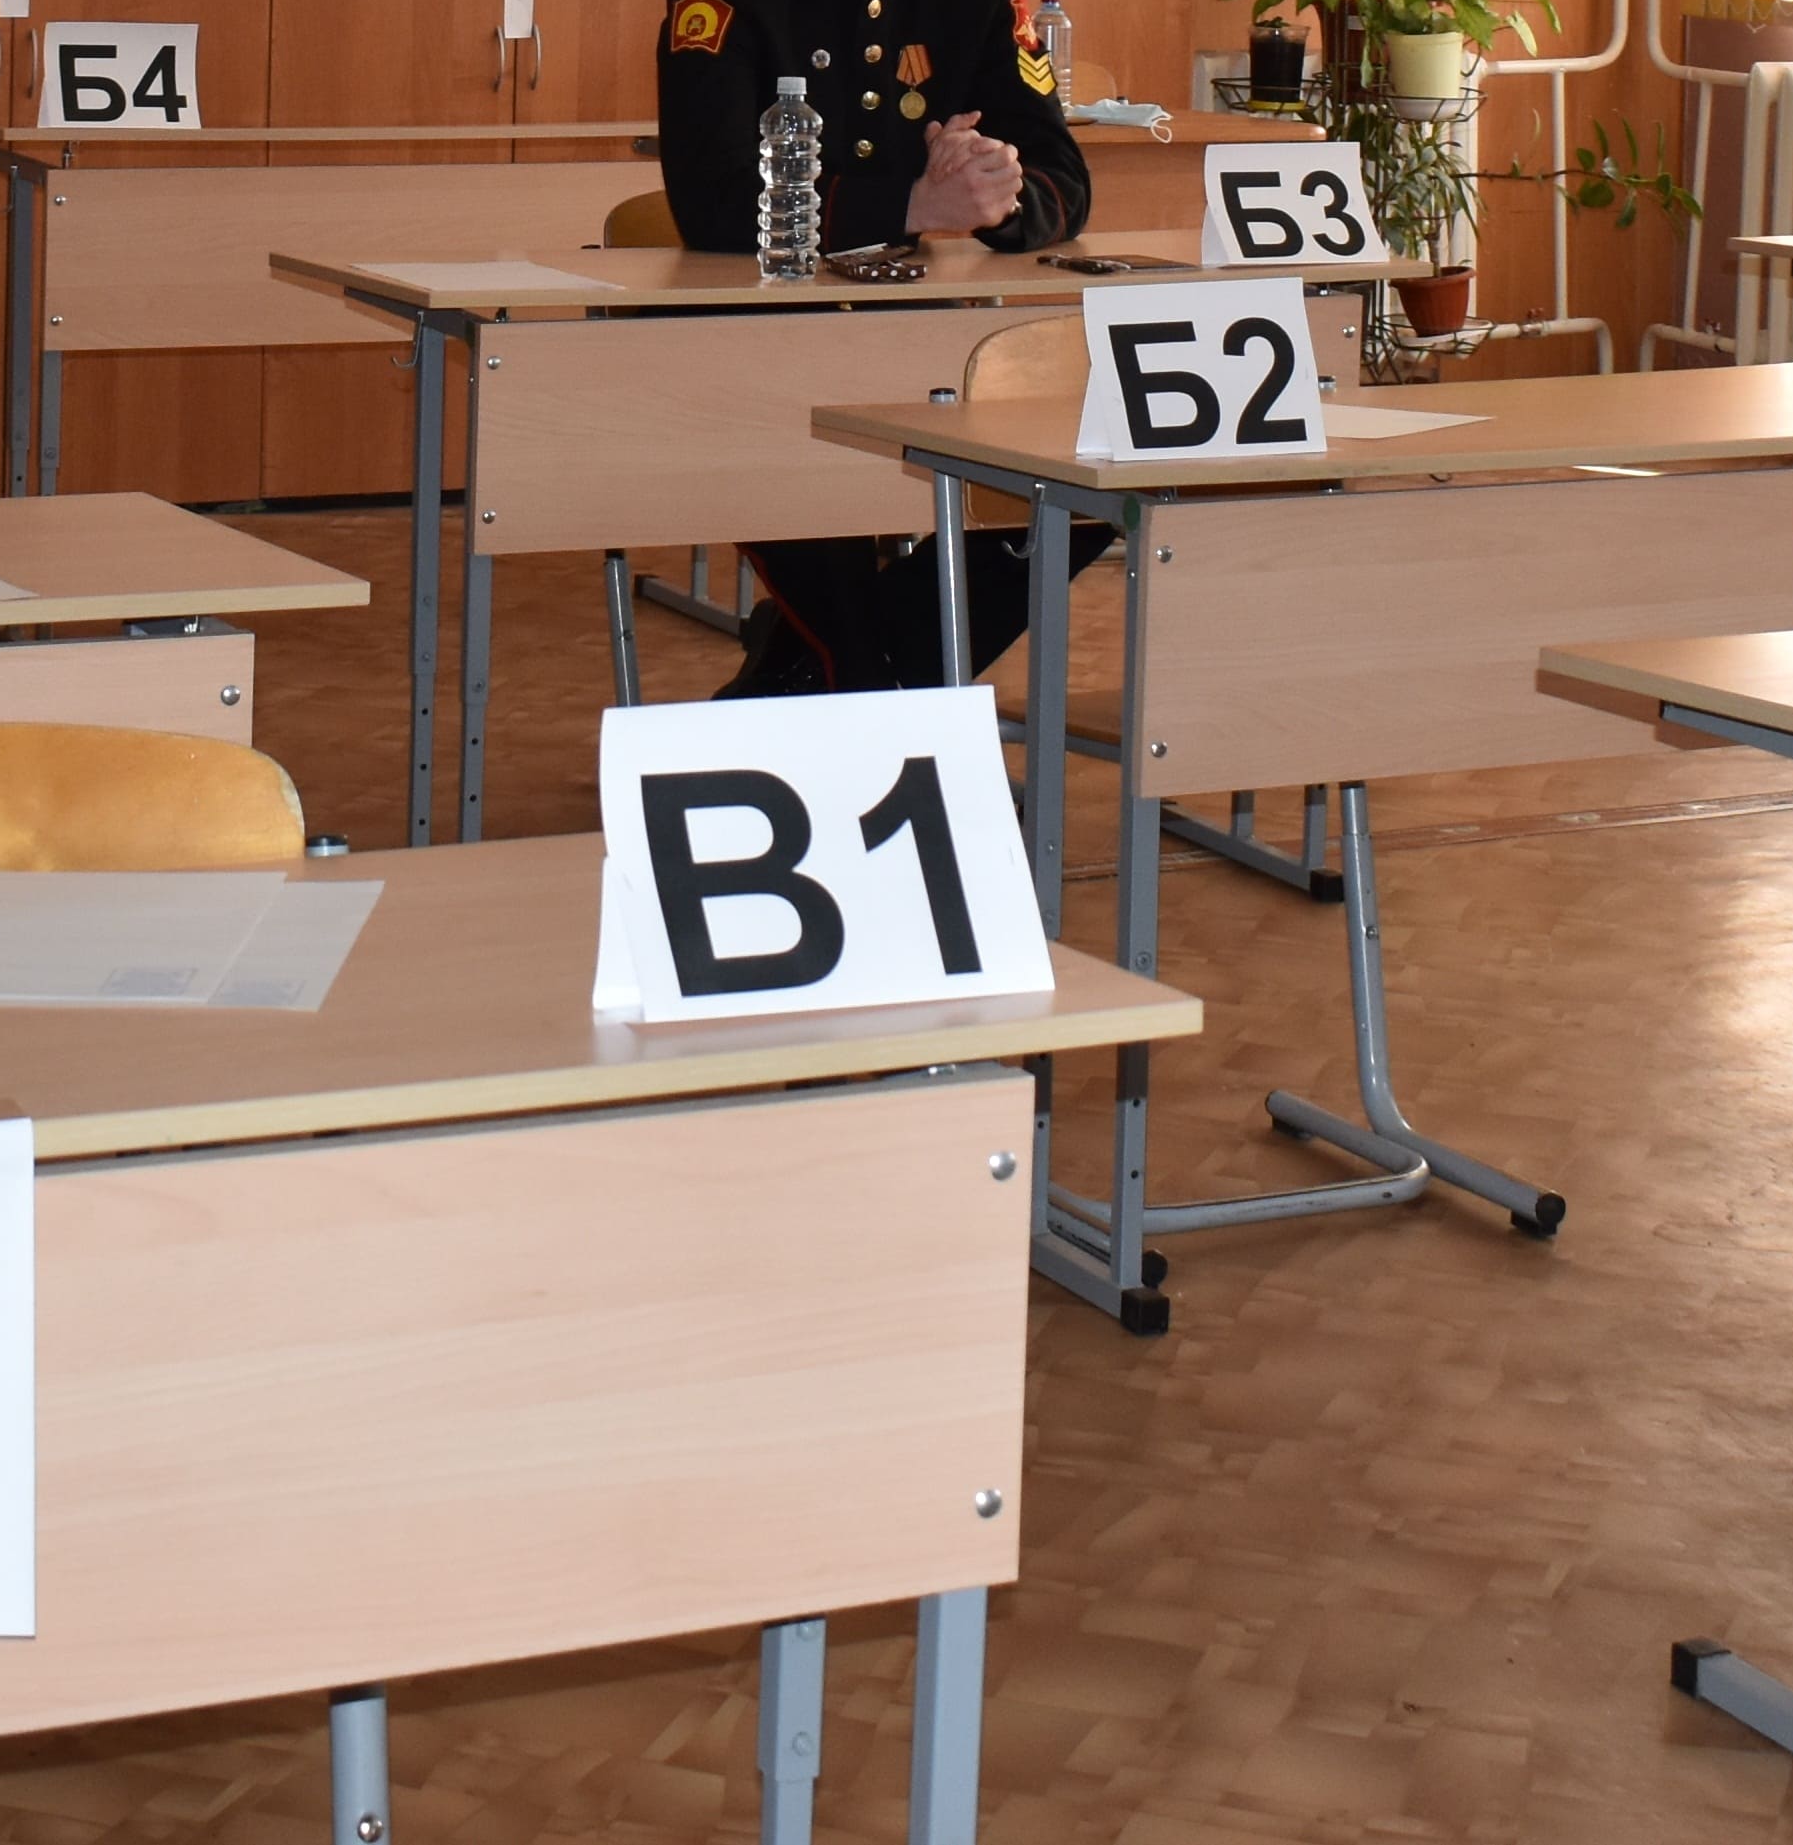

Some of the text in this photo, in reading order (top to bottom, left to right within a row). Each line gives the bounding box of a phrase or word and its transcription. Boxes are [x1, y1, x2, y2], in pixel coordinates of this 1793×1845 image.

[58, 44, 188, 123] Б4
[1220, 170, 1366, 259] Б3
[1107, 316, 1308, 449] Б2
[641, 756, 982, 998] В1
